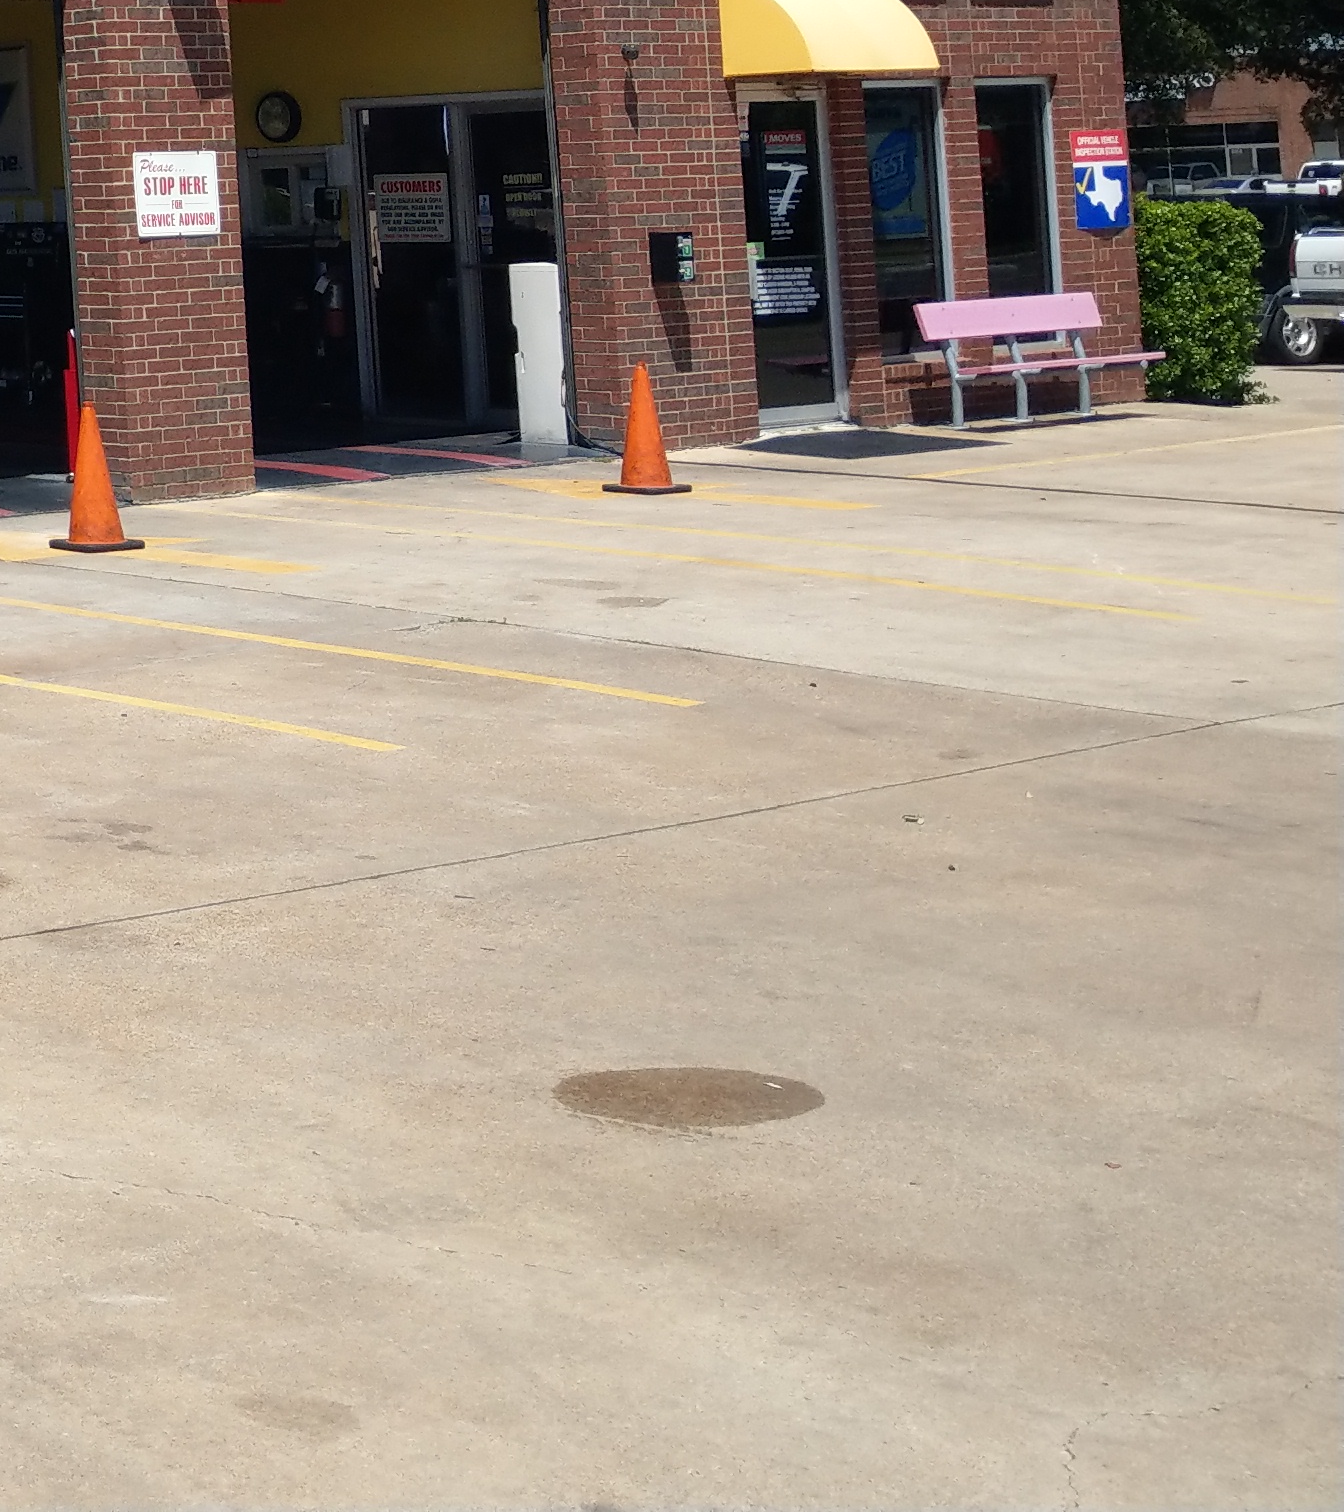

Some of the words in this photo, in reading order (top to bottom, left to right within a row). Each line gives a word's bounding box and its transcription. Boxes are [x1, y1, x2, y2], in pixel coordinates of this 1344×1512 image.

[872, 152, 906, 183] BEST
[143, 176, 174, 196] STOP
[179, 176, 208, 195] HERE
[380, 180, 442, 193] CUSTOMERS
[172, 200, 182, 209] FOR
[141, 213, 176, 228] SERVICE
[178, 212, 216, 227] ADVISOR
